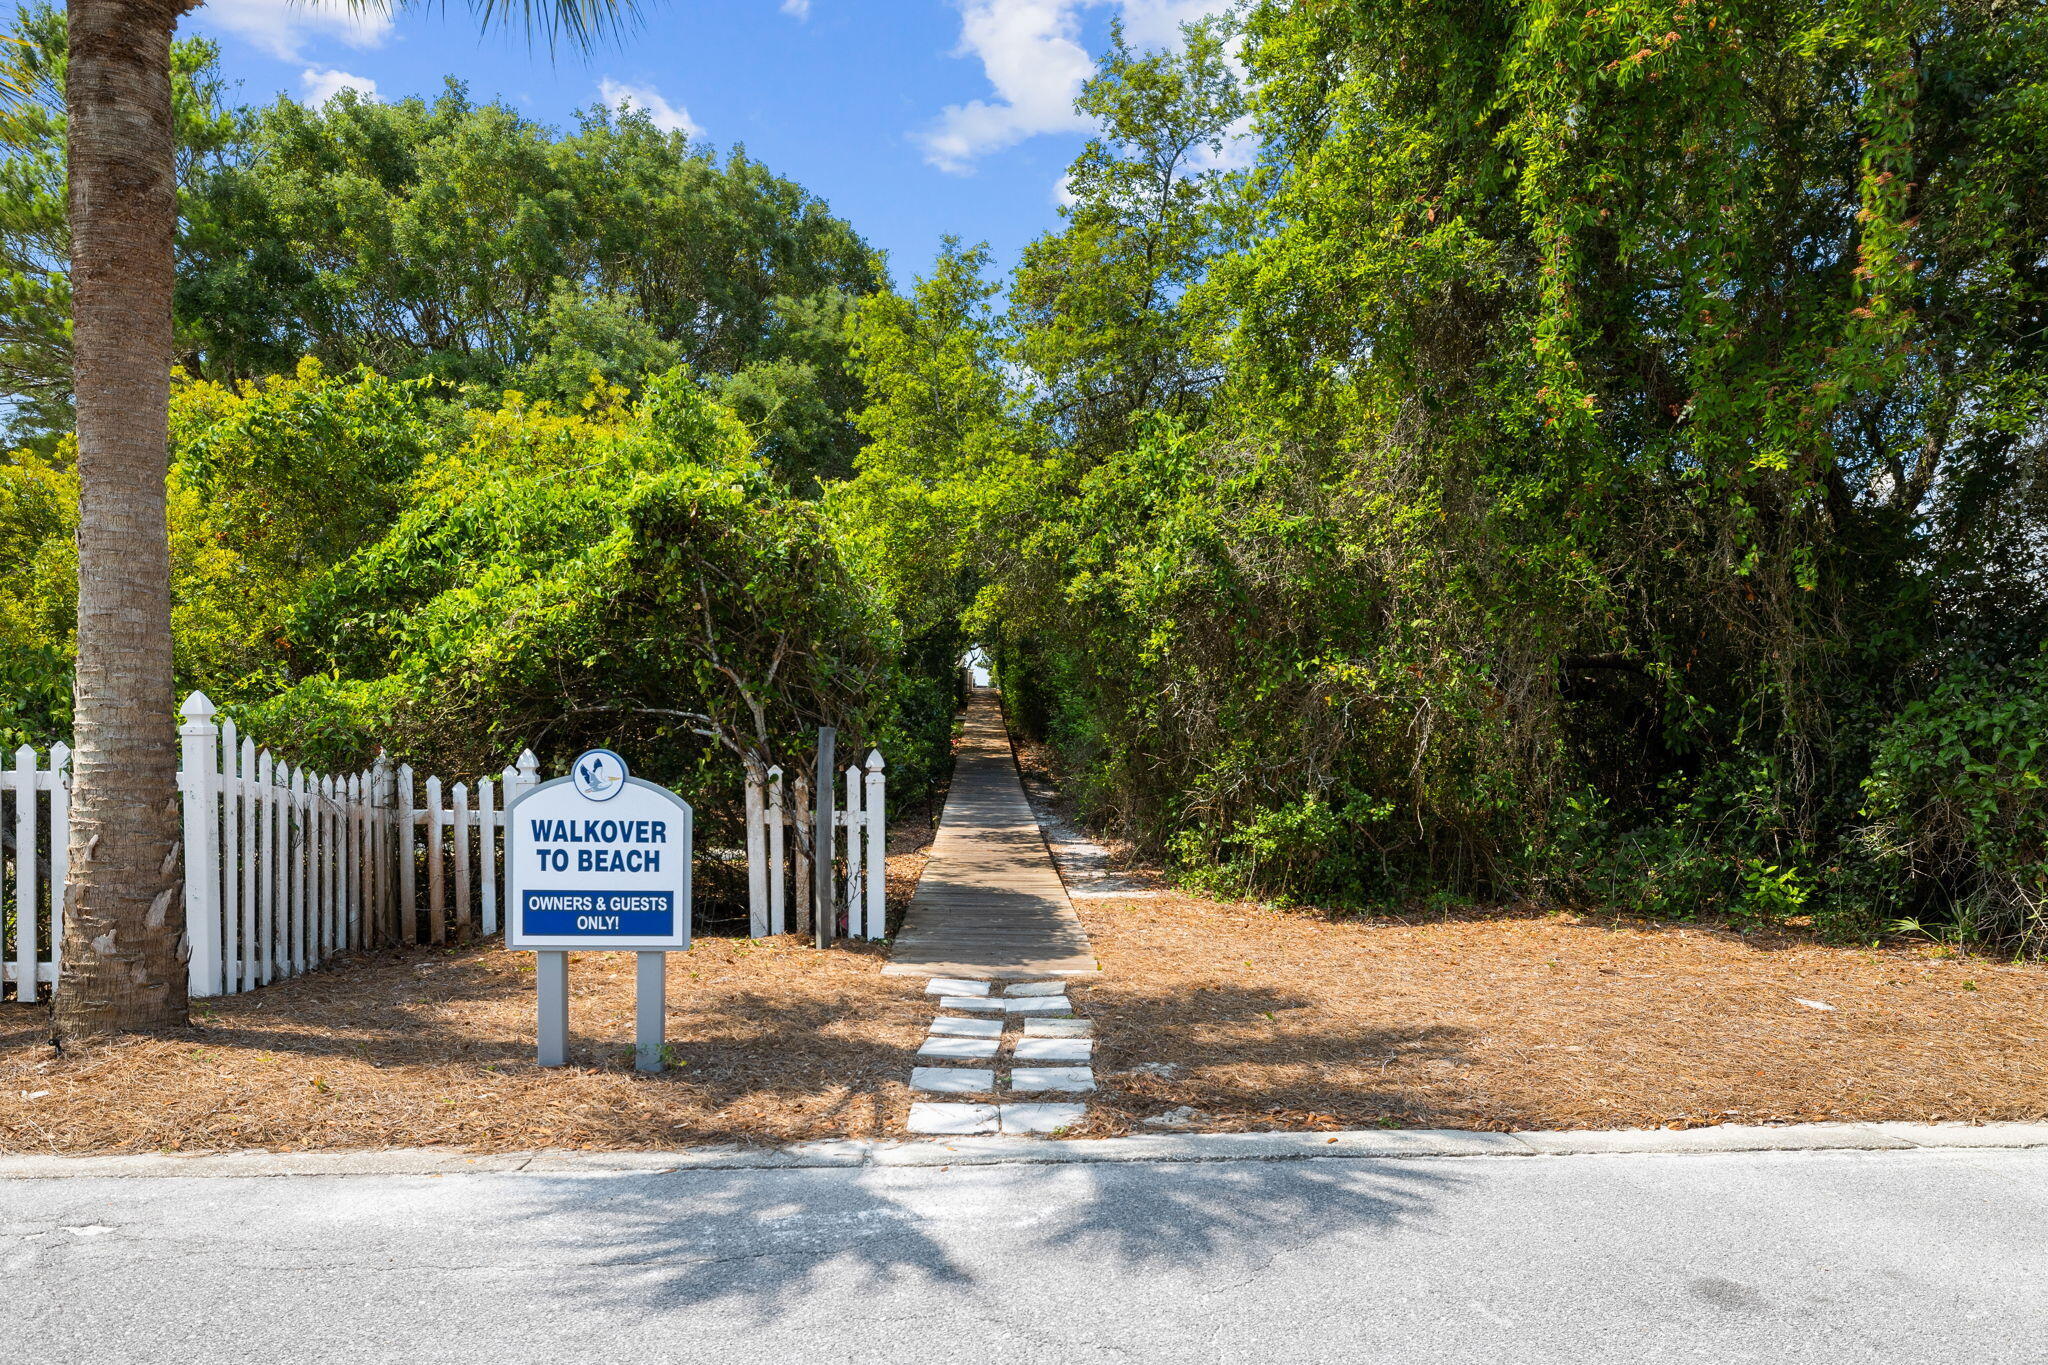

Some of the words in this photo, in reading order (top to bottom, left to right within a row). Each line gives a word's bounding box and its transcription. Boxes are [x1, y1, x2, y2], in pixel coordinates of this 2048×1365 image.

[530, 819, 667, 843] WALKOVER
[536, 848, 569, 872] TO
[577, 849, 660, 872] BEACH
[528, 896, 592, 911] OWNERS
[595, 897, 606, 910] &
[610, 896, 667, 911] GUESTS
[577, 915, 619, 930] ONLY!
